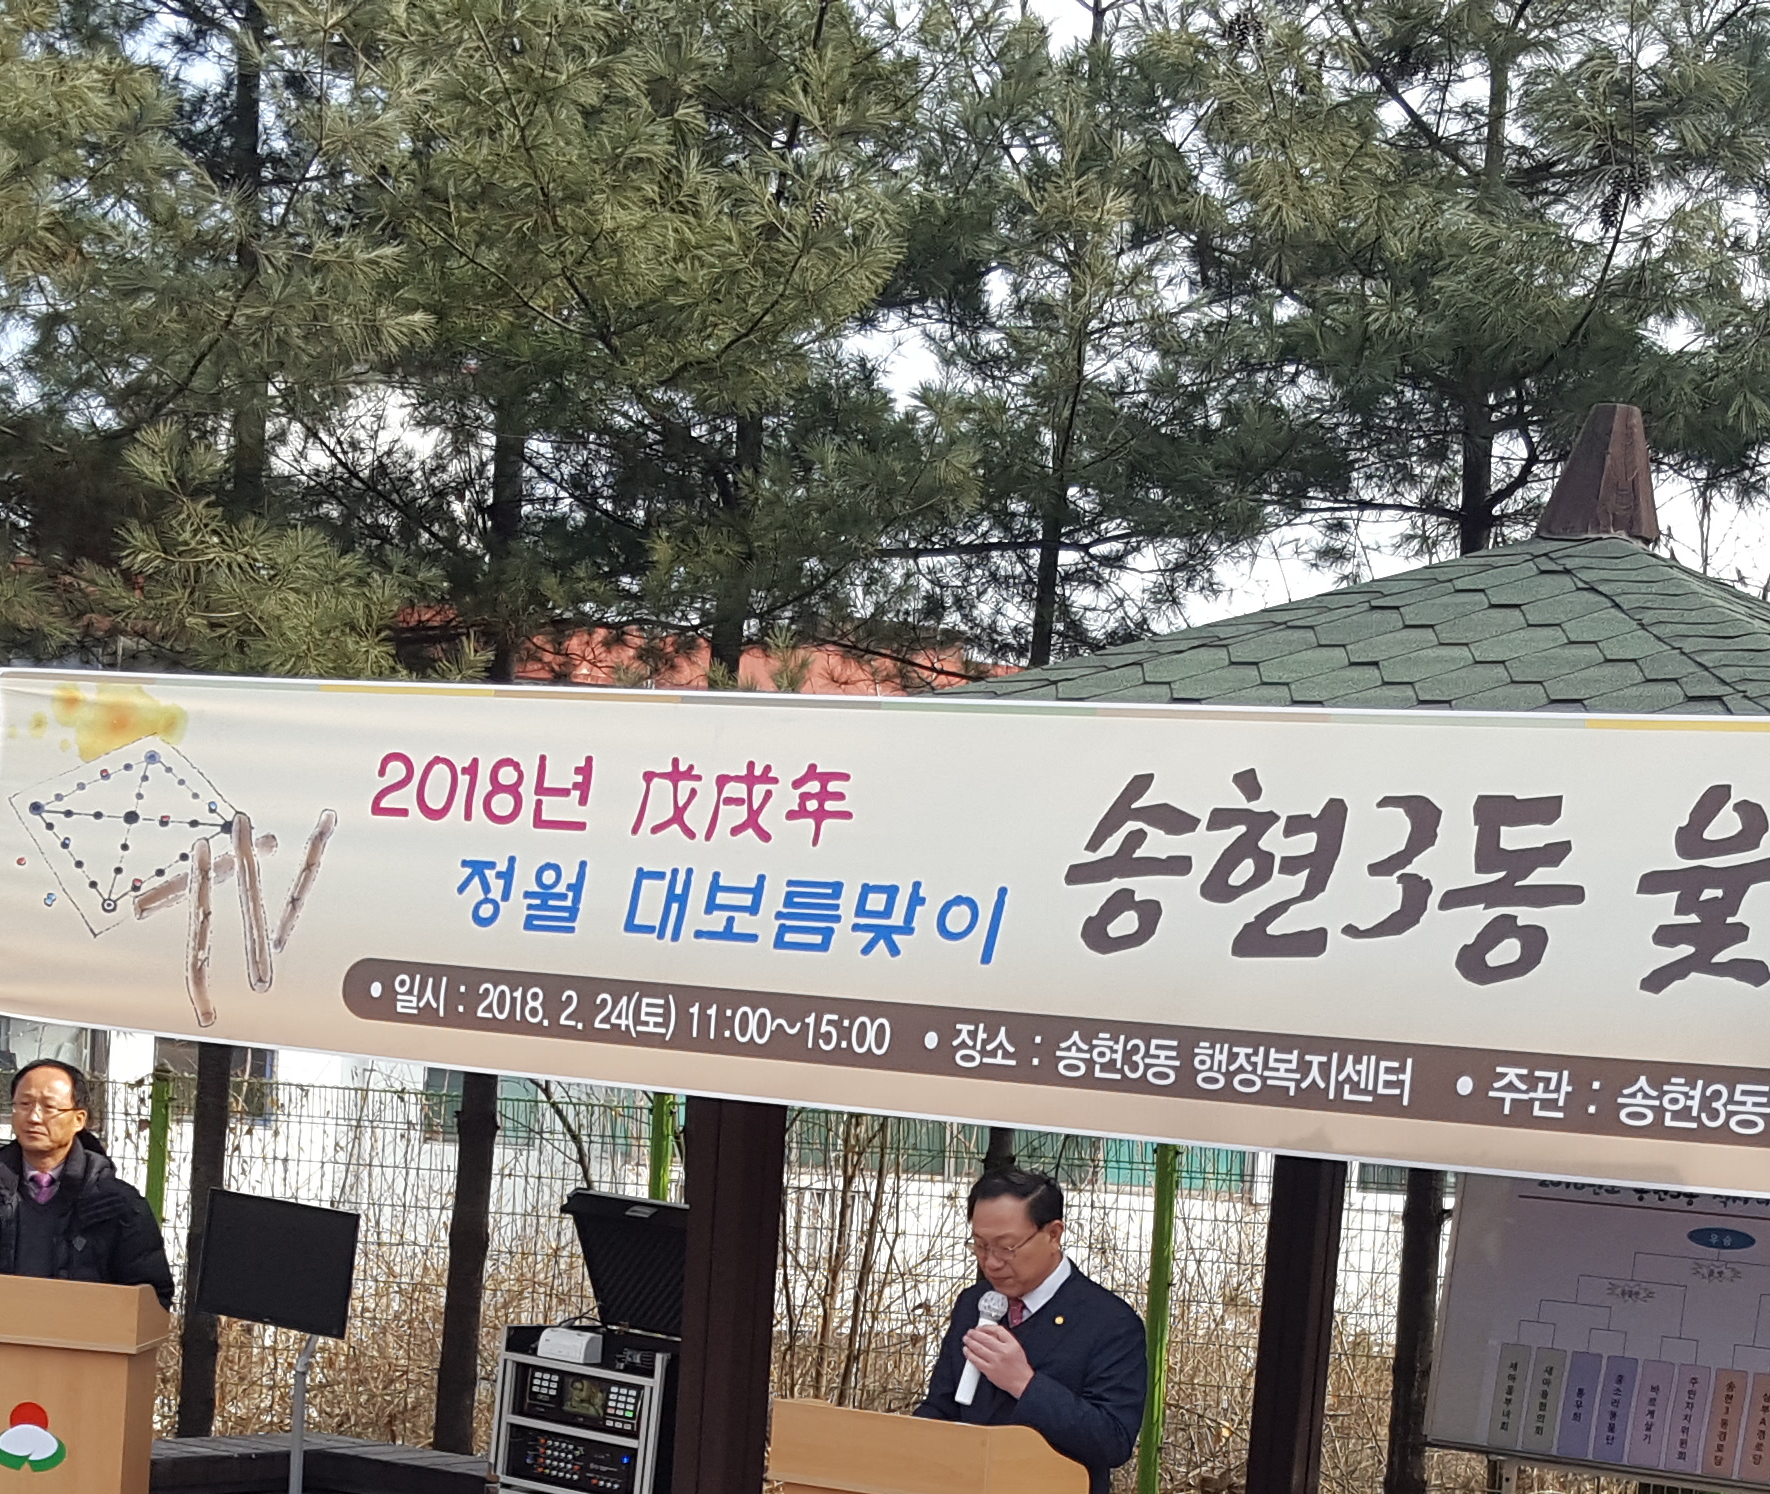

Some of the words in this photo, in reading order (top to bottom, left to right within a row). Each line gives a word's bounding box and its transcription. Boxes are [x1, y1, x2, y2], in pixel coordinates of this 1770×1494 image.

[370, 751, 594, 831] 2018년
[630, 756, 854, 848] 戊戌年
[457, 855, 587, 933] 정월
[623, 866, 1008, 965] 대보름맞이
[1064, 767, 1586, 986] 송현3동
[394, 973, 448, 1018] 일시
[477, 982, 549, 1028] 2018.
[559, 989, 584, 1031] 2.
[593, 991, 676, 1040] 24(토)
[688, 1001, 891, 1055] 11:00~15:00
[951, 1023, 1016, 1068] 장소
[1054, 1029, 1181, 1086] 송현3동
[1193, 1040, 1413, 1106] 행정복지센터
[1487, 1066, 1572, 1120] 주관
